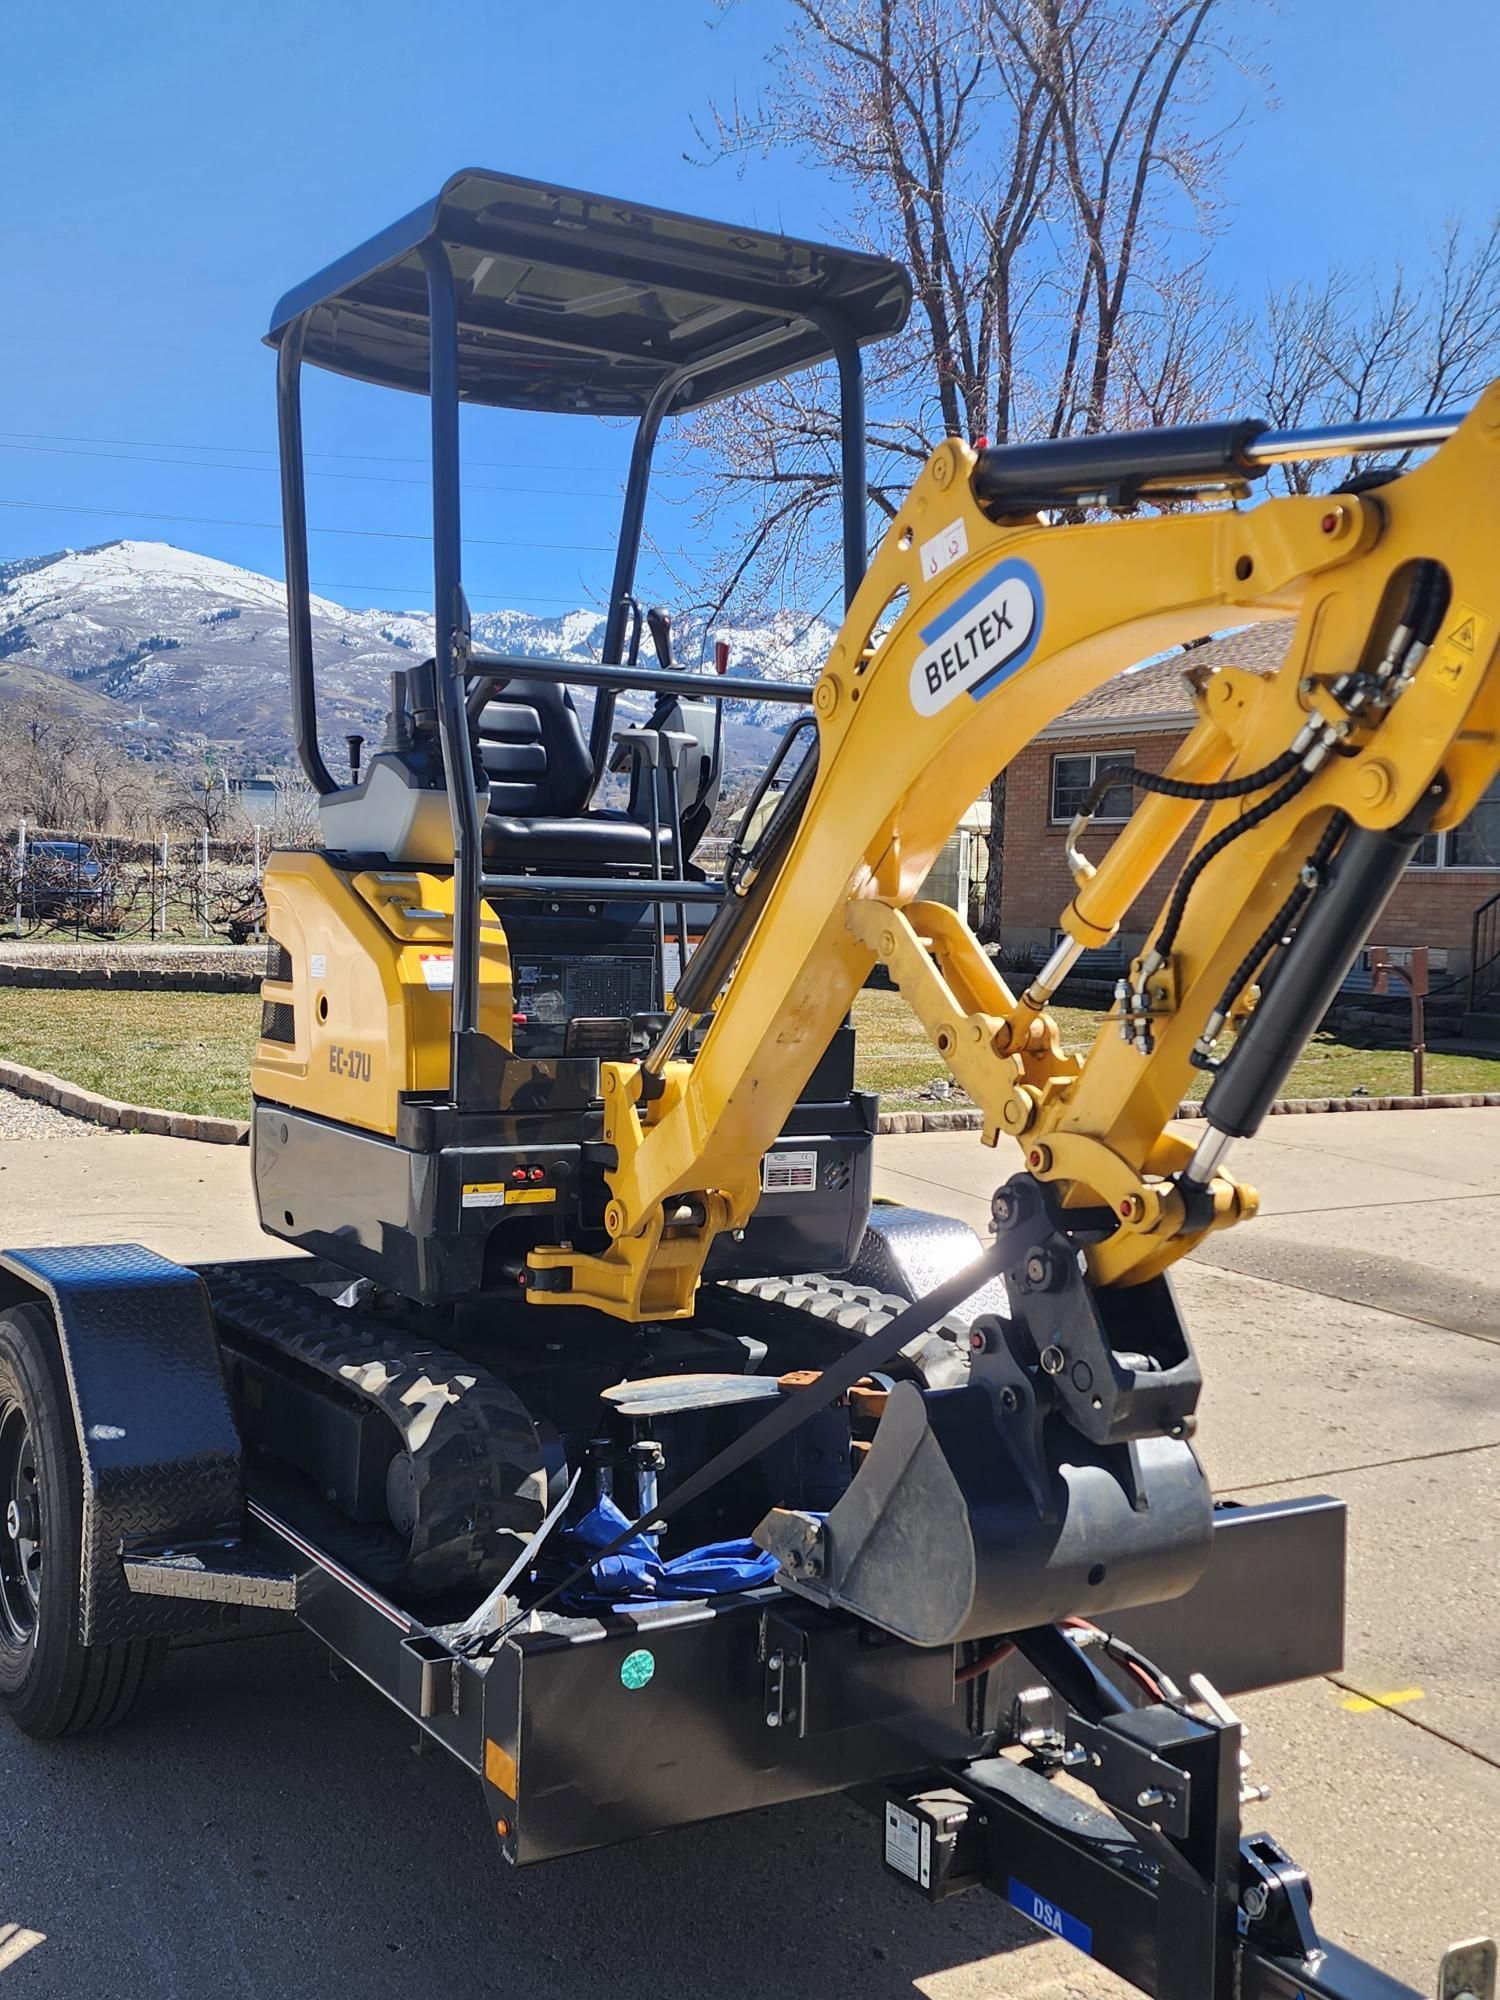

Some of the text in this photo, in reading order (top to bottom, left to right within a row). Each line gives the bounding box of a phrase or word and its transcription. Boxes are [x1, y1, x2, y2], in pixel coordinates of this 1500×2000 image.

[924, 600, 1014, 695] BELTEX
[329, 1045, 371, 1082] EC-17U
[1033, 1896, 1063, 1934] DSA
